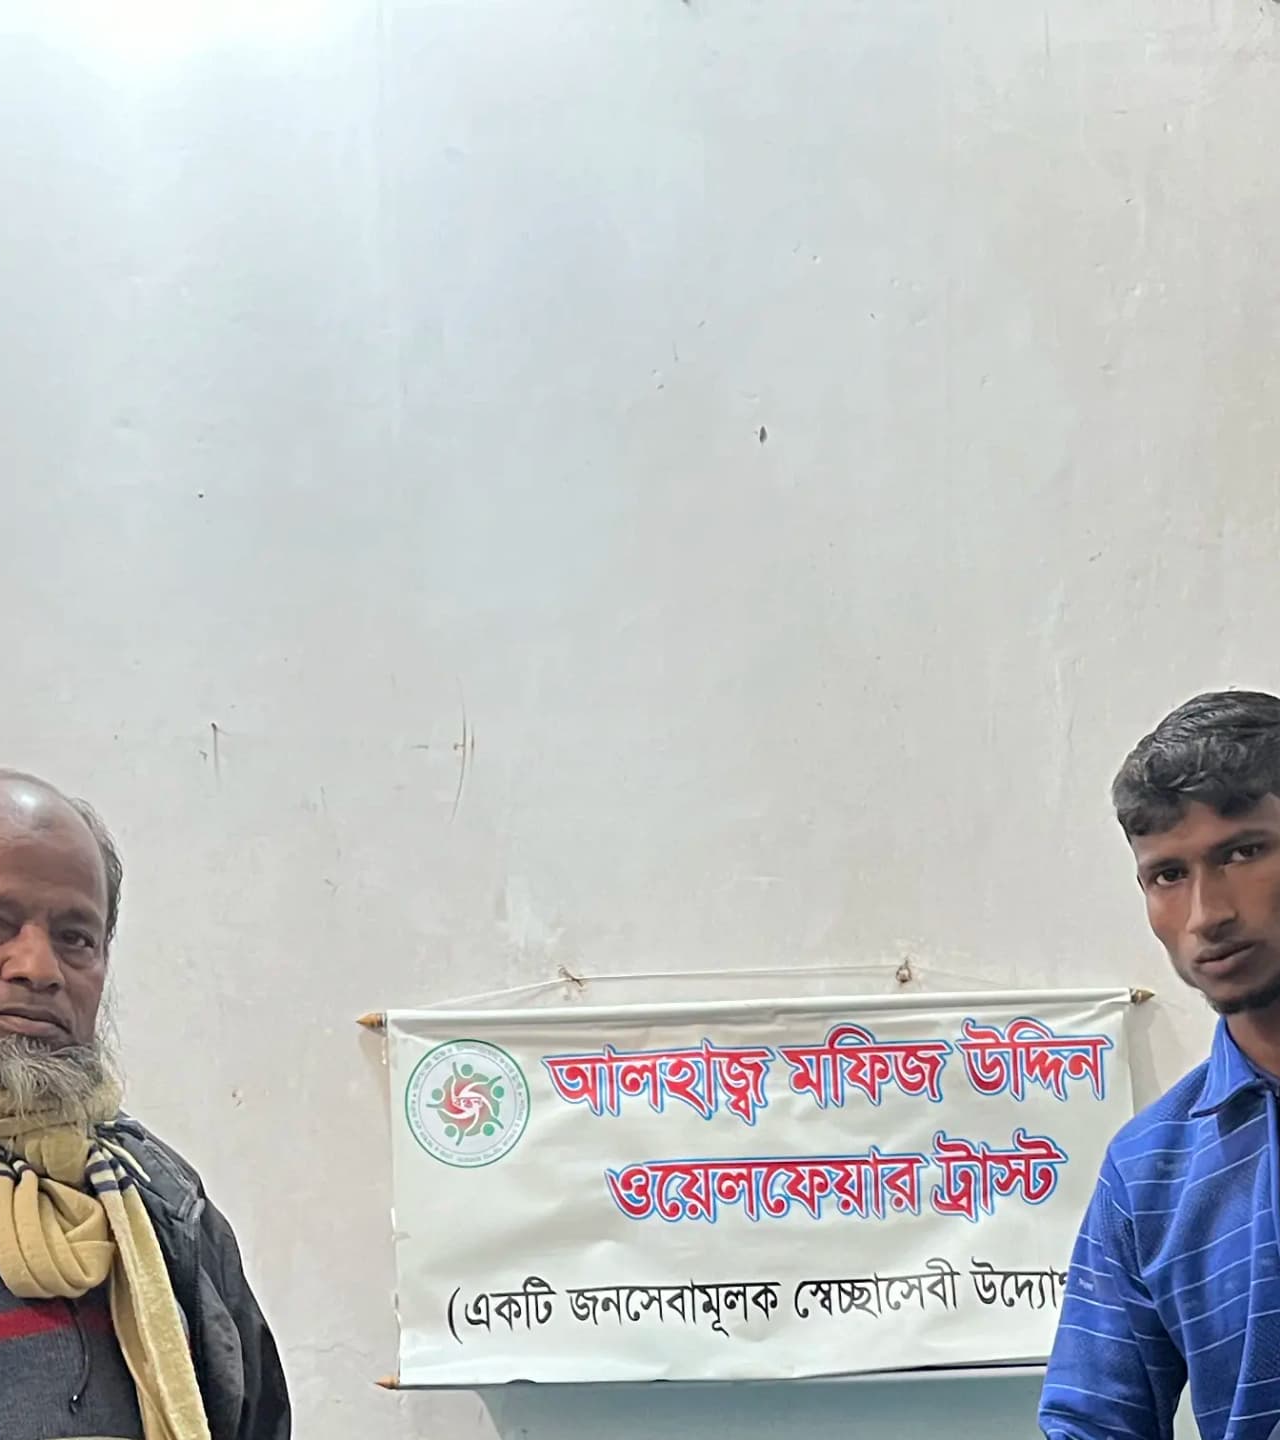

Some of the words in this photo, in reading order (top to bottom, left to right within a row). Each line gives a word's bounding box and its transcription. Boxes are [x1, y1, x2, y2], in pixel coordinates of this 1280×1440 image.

[542, 1037, 777, 1126] আলহাজ্ব
[778, 1022, 954, 1109] মফিজ
[955, 1016, 1114, 1101] উদ্দিন
[604, 1145, 928, 1222] ওয়েলফেয়ার
[930, 1128, 1068, 1222] ট্রাস্ট
[447, 1275, 557, 1344] (একটি
[565, 1278, 781, 1337] জনসেবামূলক
[794, 1257, 961, 1319] স্বেচ্ছাসেবী
